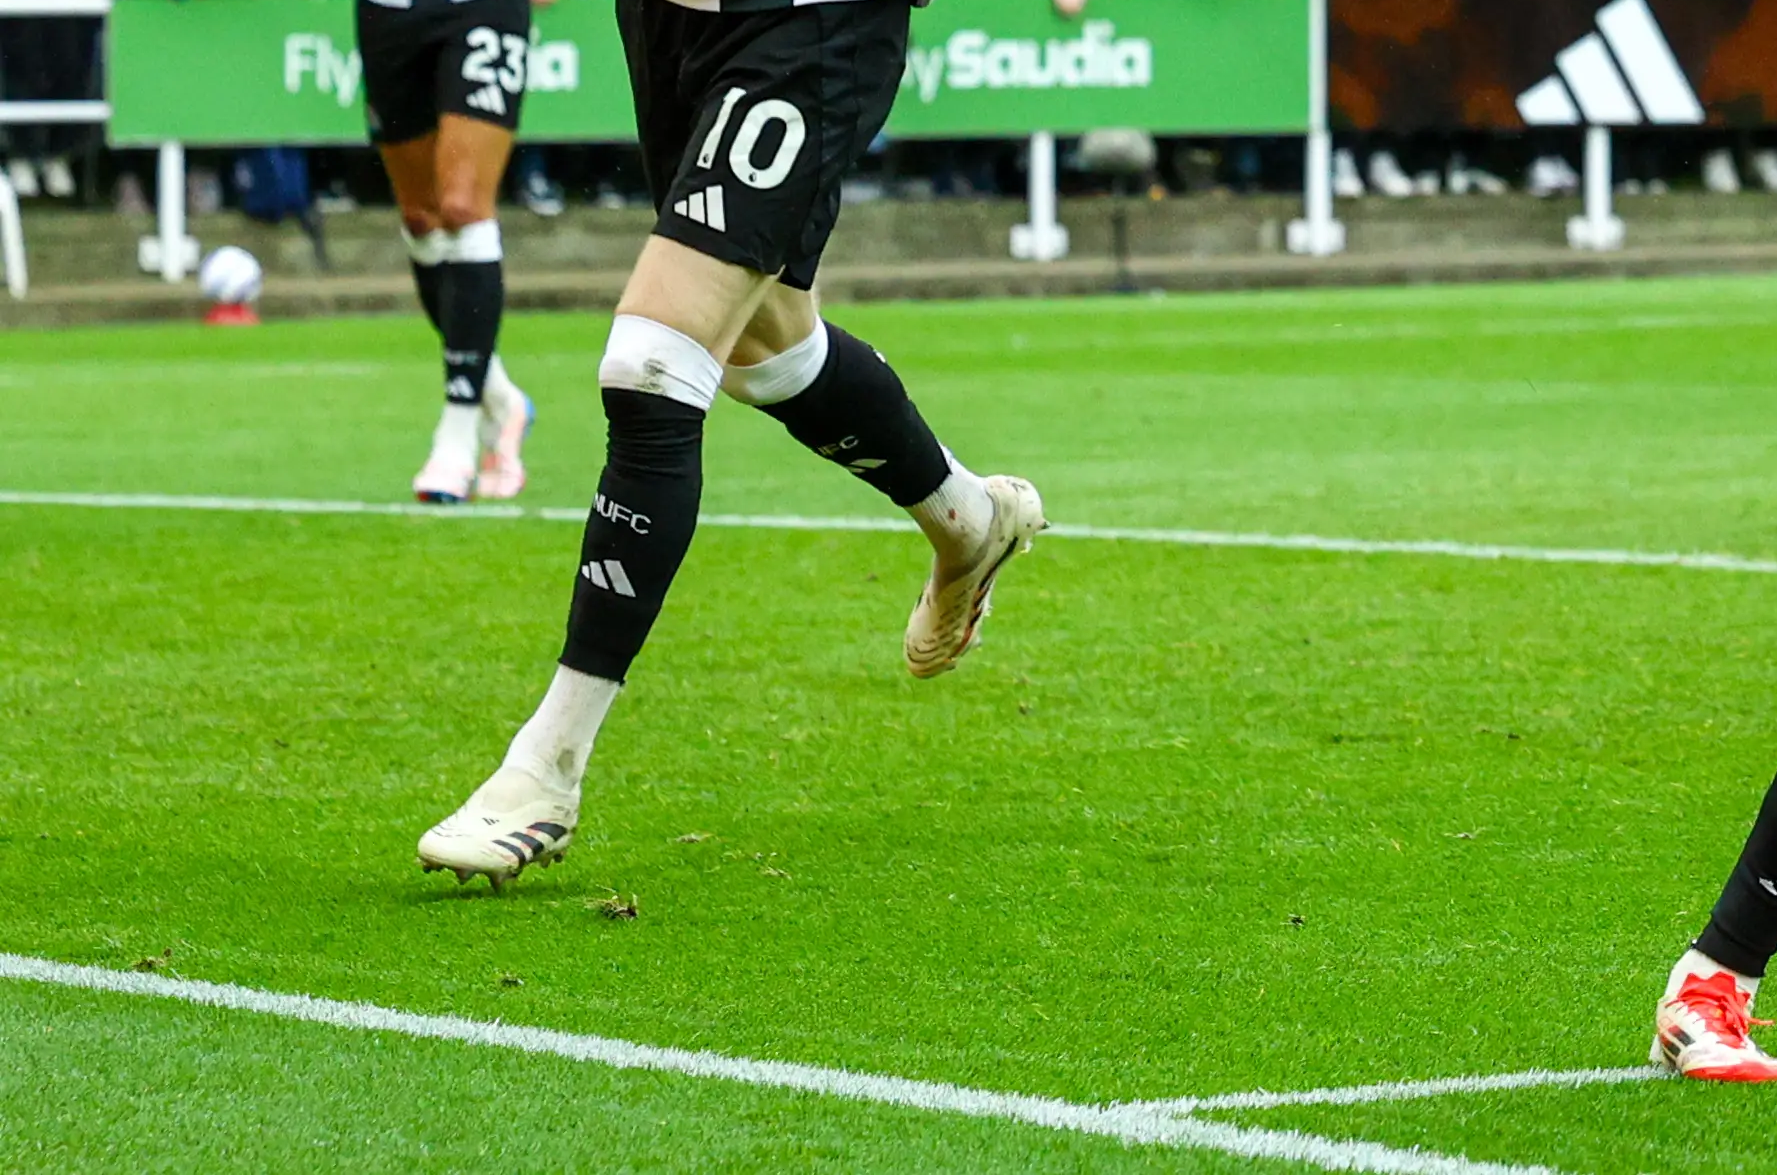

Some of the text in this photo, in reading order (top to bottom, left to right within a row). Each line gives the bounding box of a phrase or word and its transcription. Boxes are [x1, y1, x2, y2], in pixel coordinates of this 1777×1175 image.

[462, 26, 528, 94] 23
[901, 20, 1153, 104] ySaudia
[696, 86, 806, 190] 10
